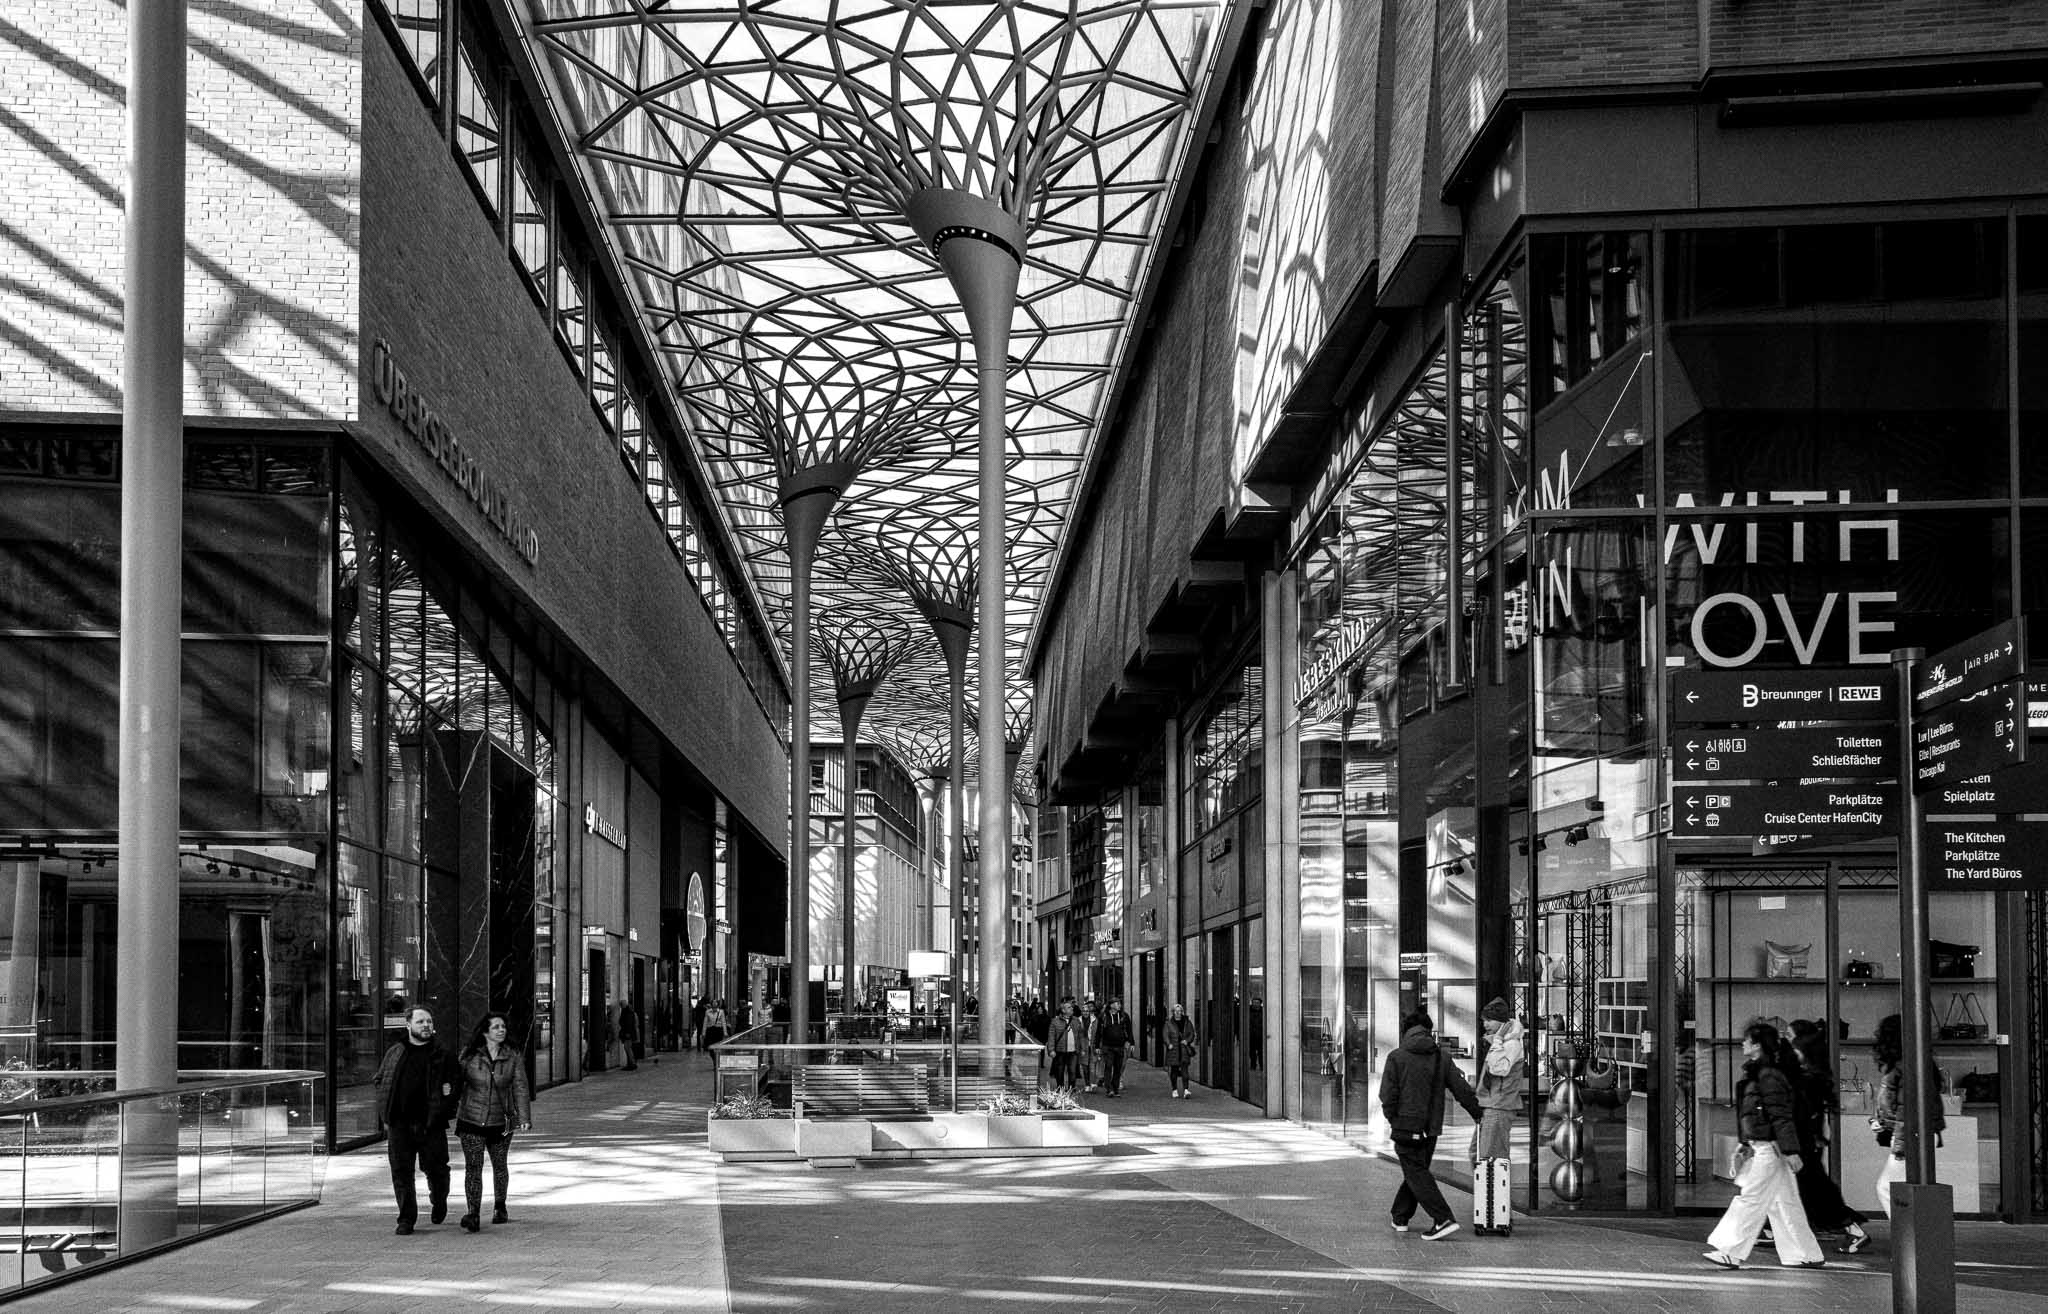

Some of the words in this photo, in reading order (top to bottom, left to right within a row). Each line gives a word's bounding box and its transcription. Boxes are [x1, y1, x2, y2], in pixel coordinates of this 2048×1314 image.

[1636, 489, 1899, 566] WITH
[1639, 591, 1898, 668] LOVE
[1968, 657, 1981, 670] AIR
[1984, 649, 2000, 663] BAR
[1760, 689, 1823, 701] breuninger
[1841, 689, 1879, 699] REWE
[1930, 727, 1940, 739] Lee
[1836, 737, 1882, 748] Toiletten
[1931, 738, 1961, 756] Restaurants
[1812, 755, 1882, 767] Schließfächer
[1828, 794, 1883, 806] Parkplätze
[1943, 791, 1996, 803] Spielplatz
[1764, 813, 1797, 824] Cruise
[1797, 813, 1831, 824] Center
[1832, 812, 1883, 825] HafenCity
[1944, 832, 1965, 843] The
[1965, 832, 2006, 843] Kitchen
[1945, 850, 2000, 863] Parkplätze
[1945, 868, 1965, 879] The
[1966, 868, 1990, 879] Yard
[1992, 867, 2022, 879] Büros
